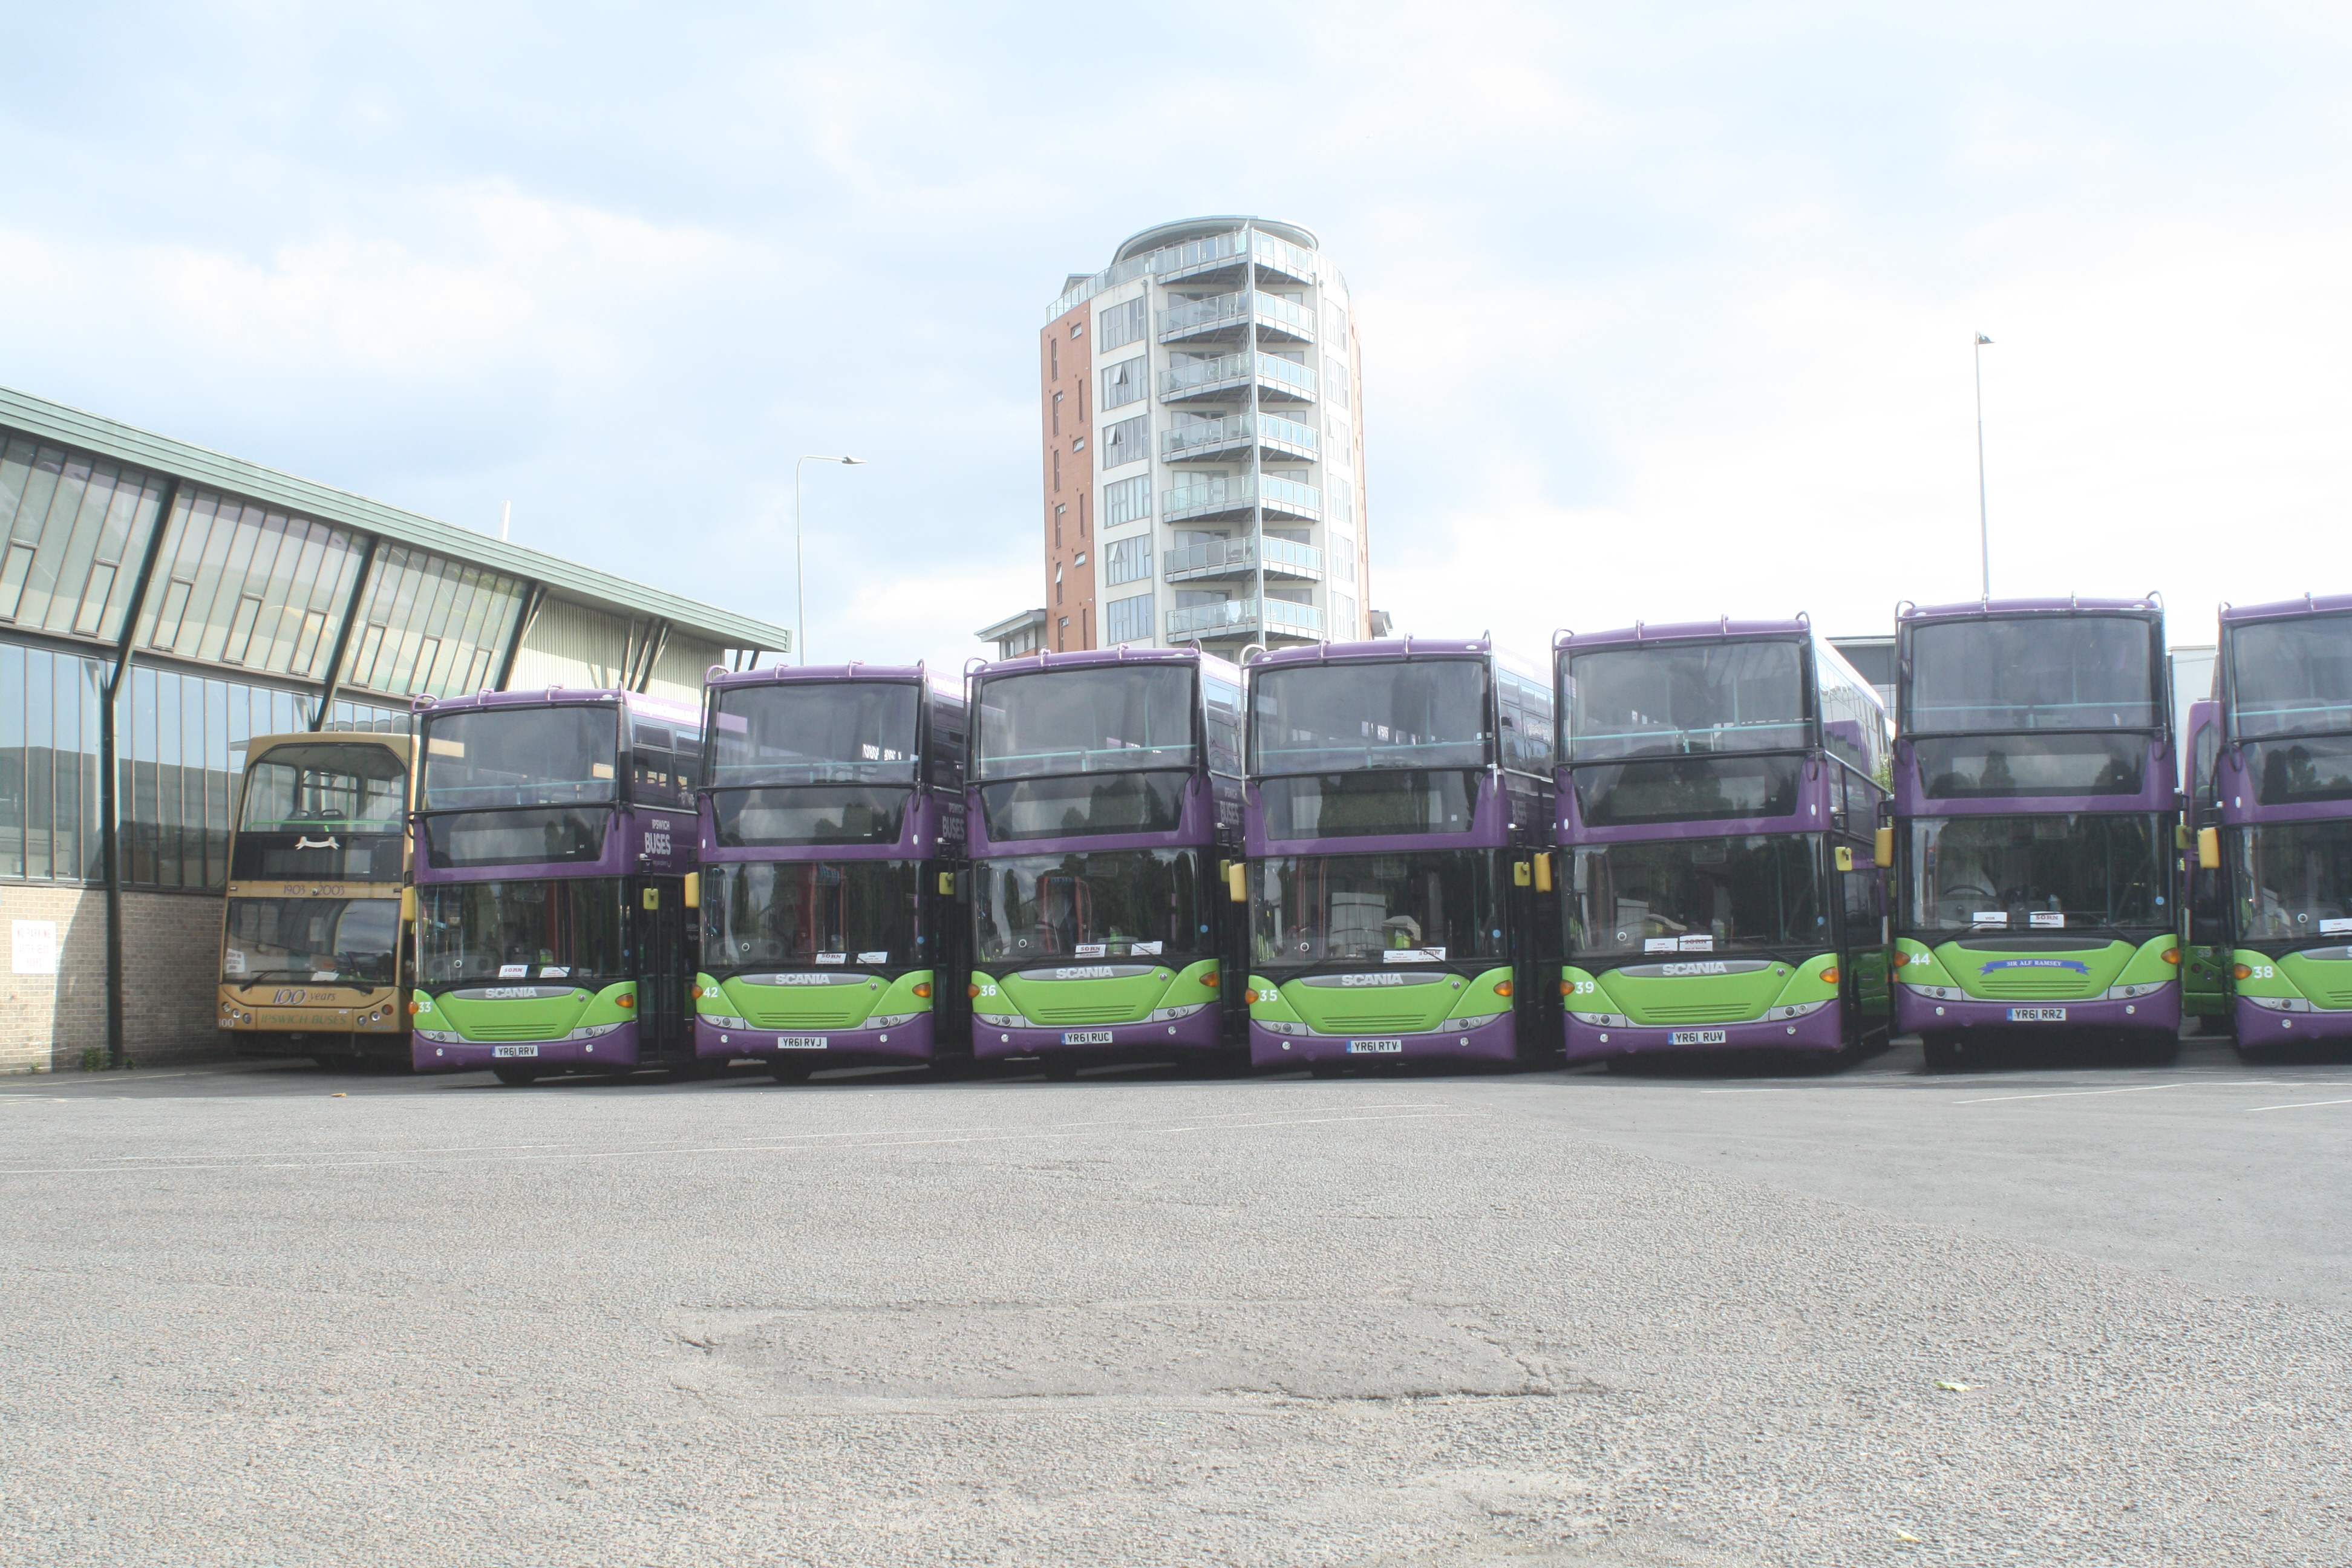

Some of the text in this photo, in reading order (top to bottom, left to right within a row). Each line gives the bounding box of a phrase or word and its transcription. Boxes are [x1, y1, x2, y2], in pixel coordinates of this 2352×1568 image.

[652, 819, 670, 831] IPSWICH
[942, 815, 965, 840] BUSES
[645, 832, 671, 855] BUSES
[284, 884, 345, 895] 1903 2003
[1910, 953, 1930, 965] 44
[1056, 966, 1114, 979] SCANIA
[1662, 962, 1727, 976] SCANIA
[2253, 965, 2273, 979] 38
[775, 974, 831, 984] SCANIA
[1341, 973, 1403, 986] SCANIA
[485, 987, 537, 998] SCANIA
[703, 987, 719, 998] 42
[981, 984, 997, 996] 36
[1575, 981, 1595, 995] 39
[273, 989, 336, 1005] 100 years
[1259, 989, 1278, 1002] 35
[418, 1001, 431, 1013] 33
[261, 1014, 348, 1025] IPSWICH BUSES
[2015, 1008, 2063, 1019] YR61 RRZ
[218, 1019, 235, 1028] 100
[783, 1038, 822, 1047] YR61 RVJ
[1067, 1033, 1110, 1043] YR61 RUC
[1676, 1032, 1723, 1043] YR61 RUV
[498, 1047, 535, 1056] YR61 RRV
[1354, 1041, 1398, 1051] YR61 RTV
